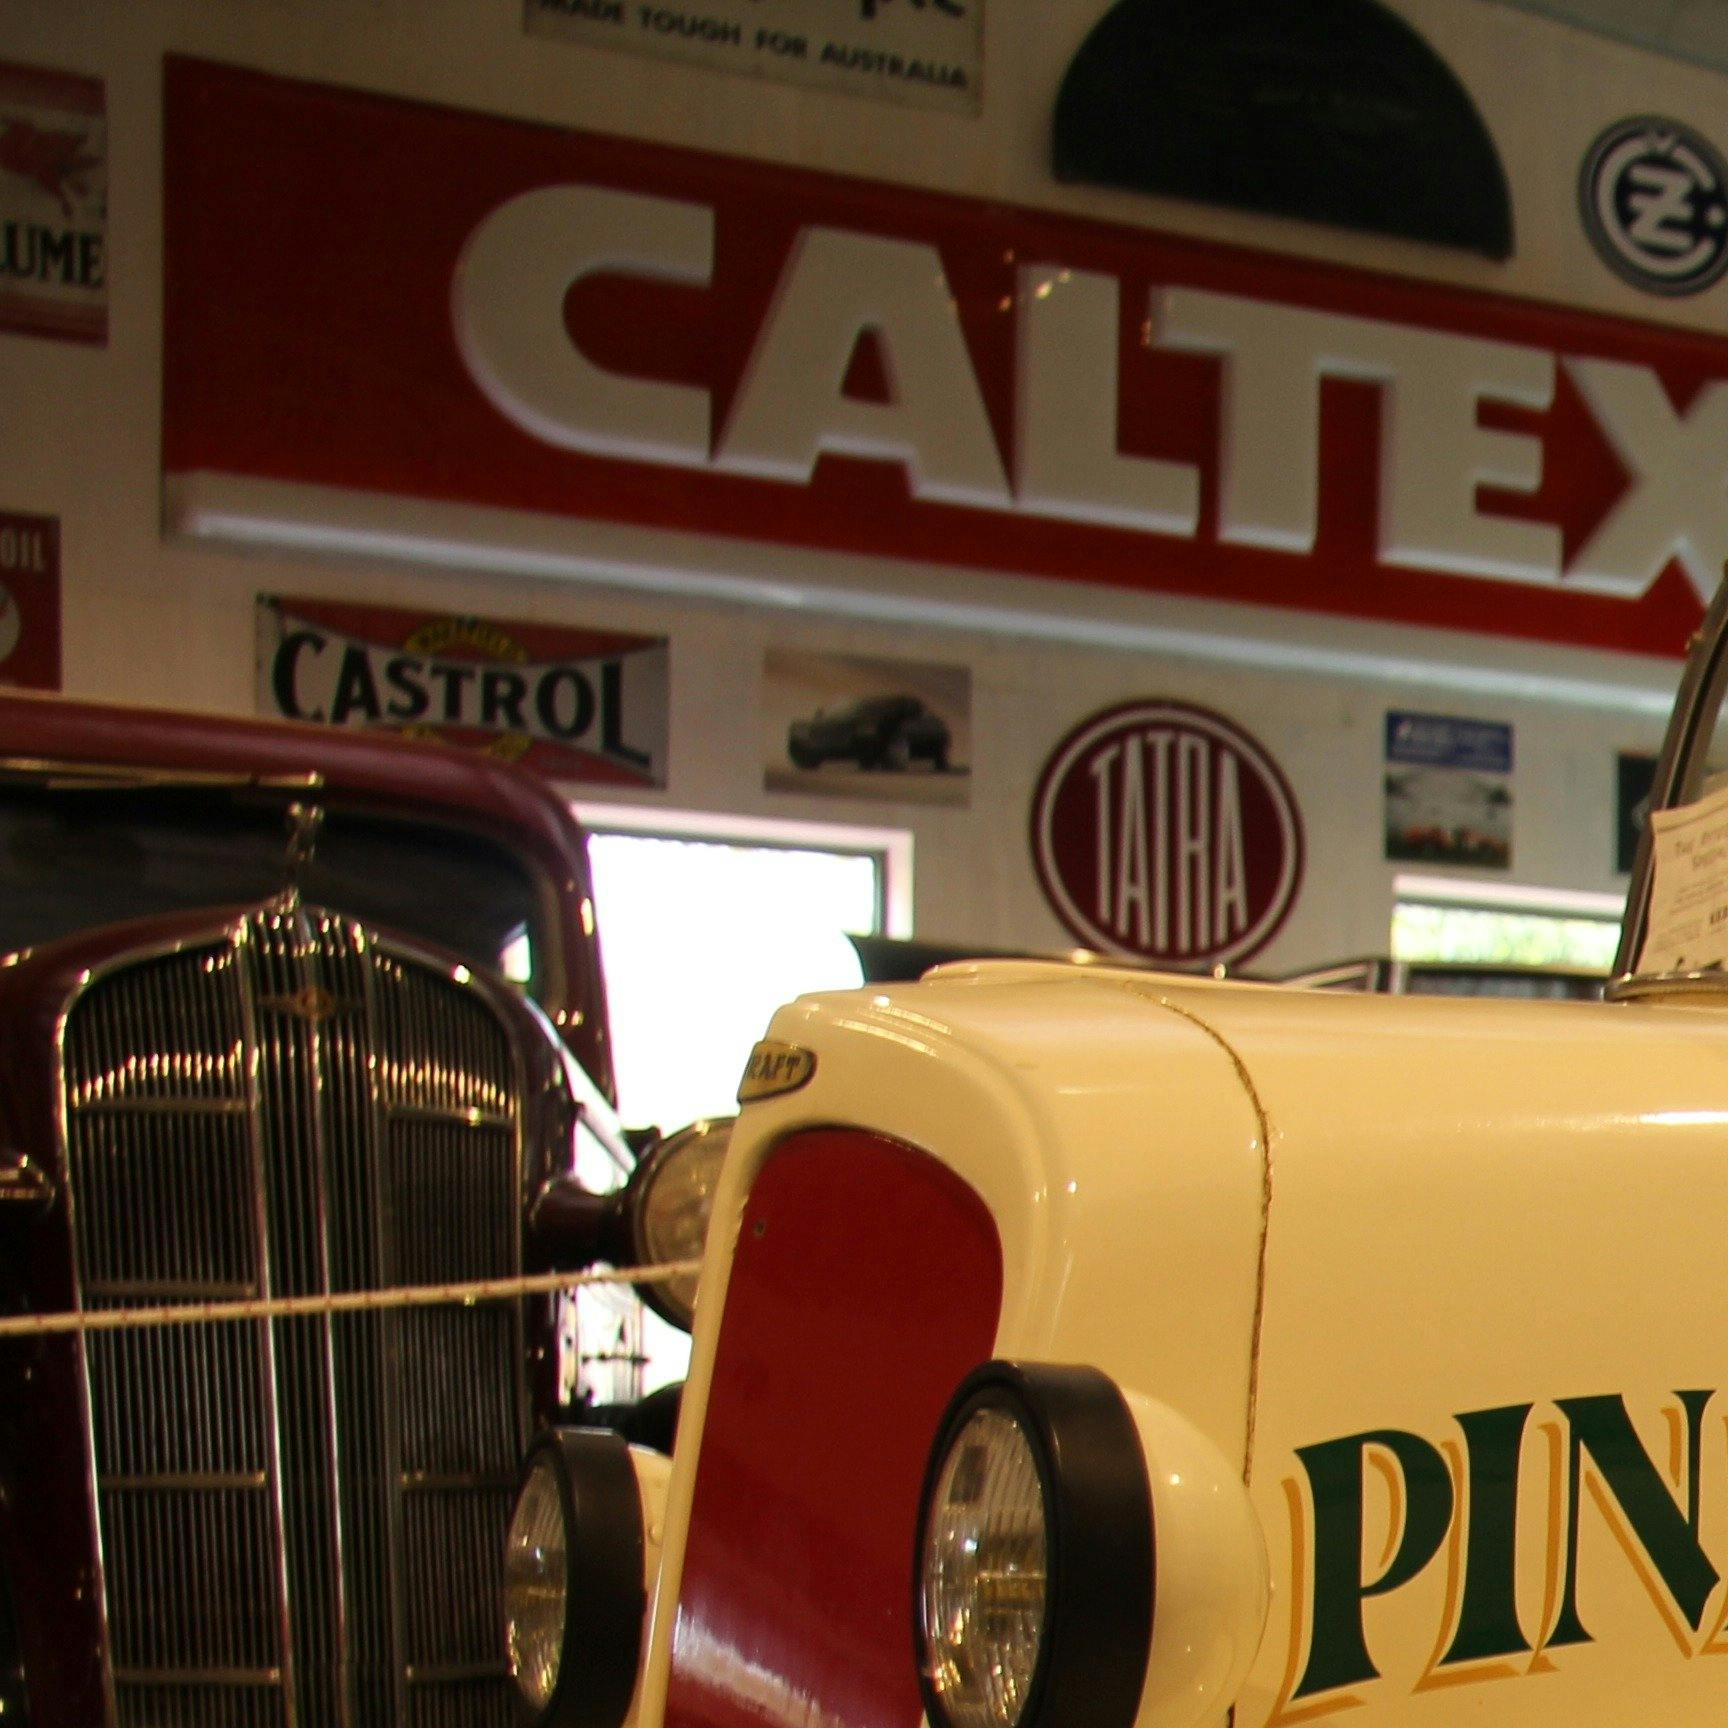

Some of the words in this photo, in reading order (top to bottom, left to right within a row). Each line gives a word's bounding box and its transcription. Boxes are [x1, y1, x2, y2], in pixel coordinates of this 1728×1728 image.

[754, 27, 808, 58] FOR
[819, 41, 968, 88] AUSTRALIA
[0, 217, 104, 290] UME
[271, 628, 652, 769] CASTROL
[1089, 731, 1251, 955] TATRA
